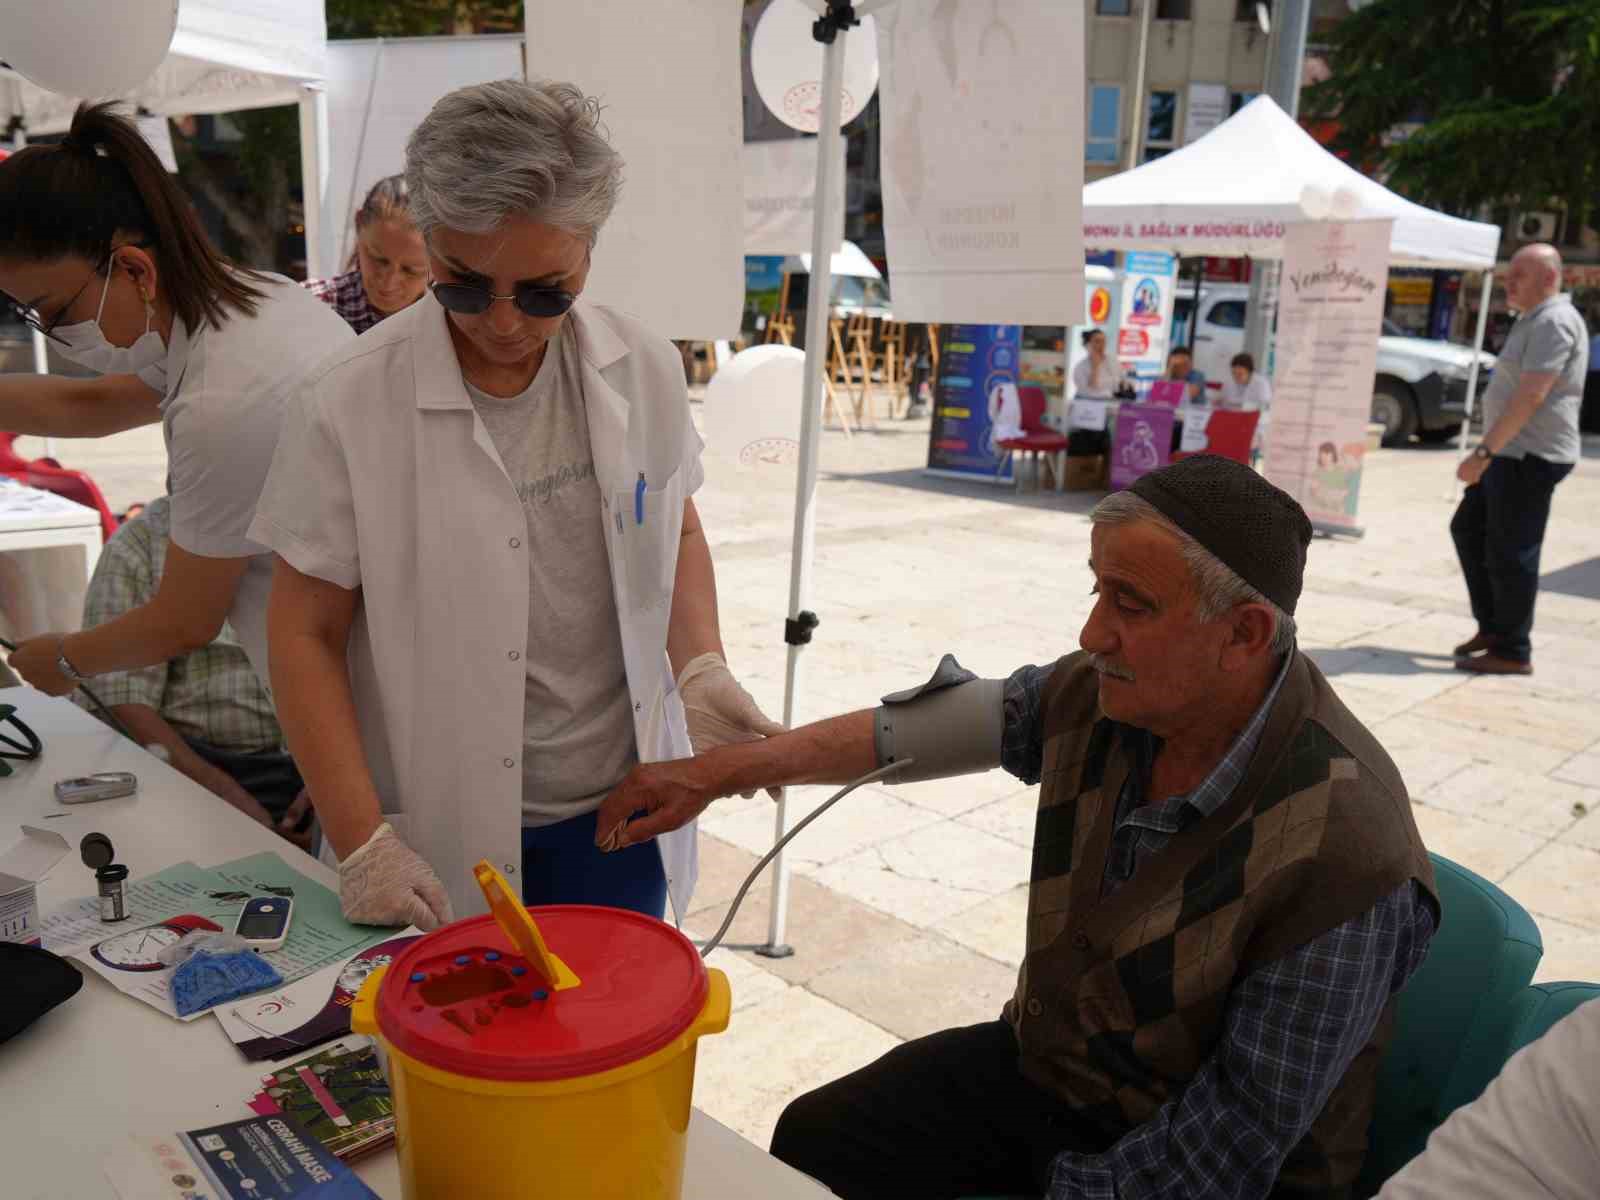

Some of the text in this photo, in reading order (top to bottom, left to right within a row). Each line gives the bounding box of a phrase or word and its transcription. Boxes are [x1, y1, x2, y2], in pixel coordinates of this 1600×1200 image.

[1140, 221, 1190, 239] SAĞLIK
[1194, 220, 1286, 239] MÜDÜRLÜĞÜ
[266, 1118, 311, 1156] CERRAHİ
[295, 1151, 333, 1184] MASKE
